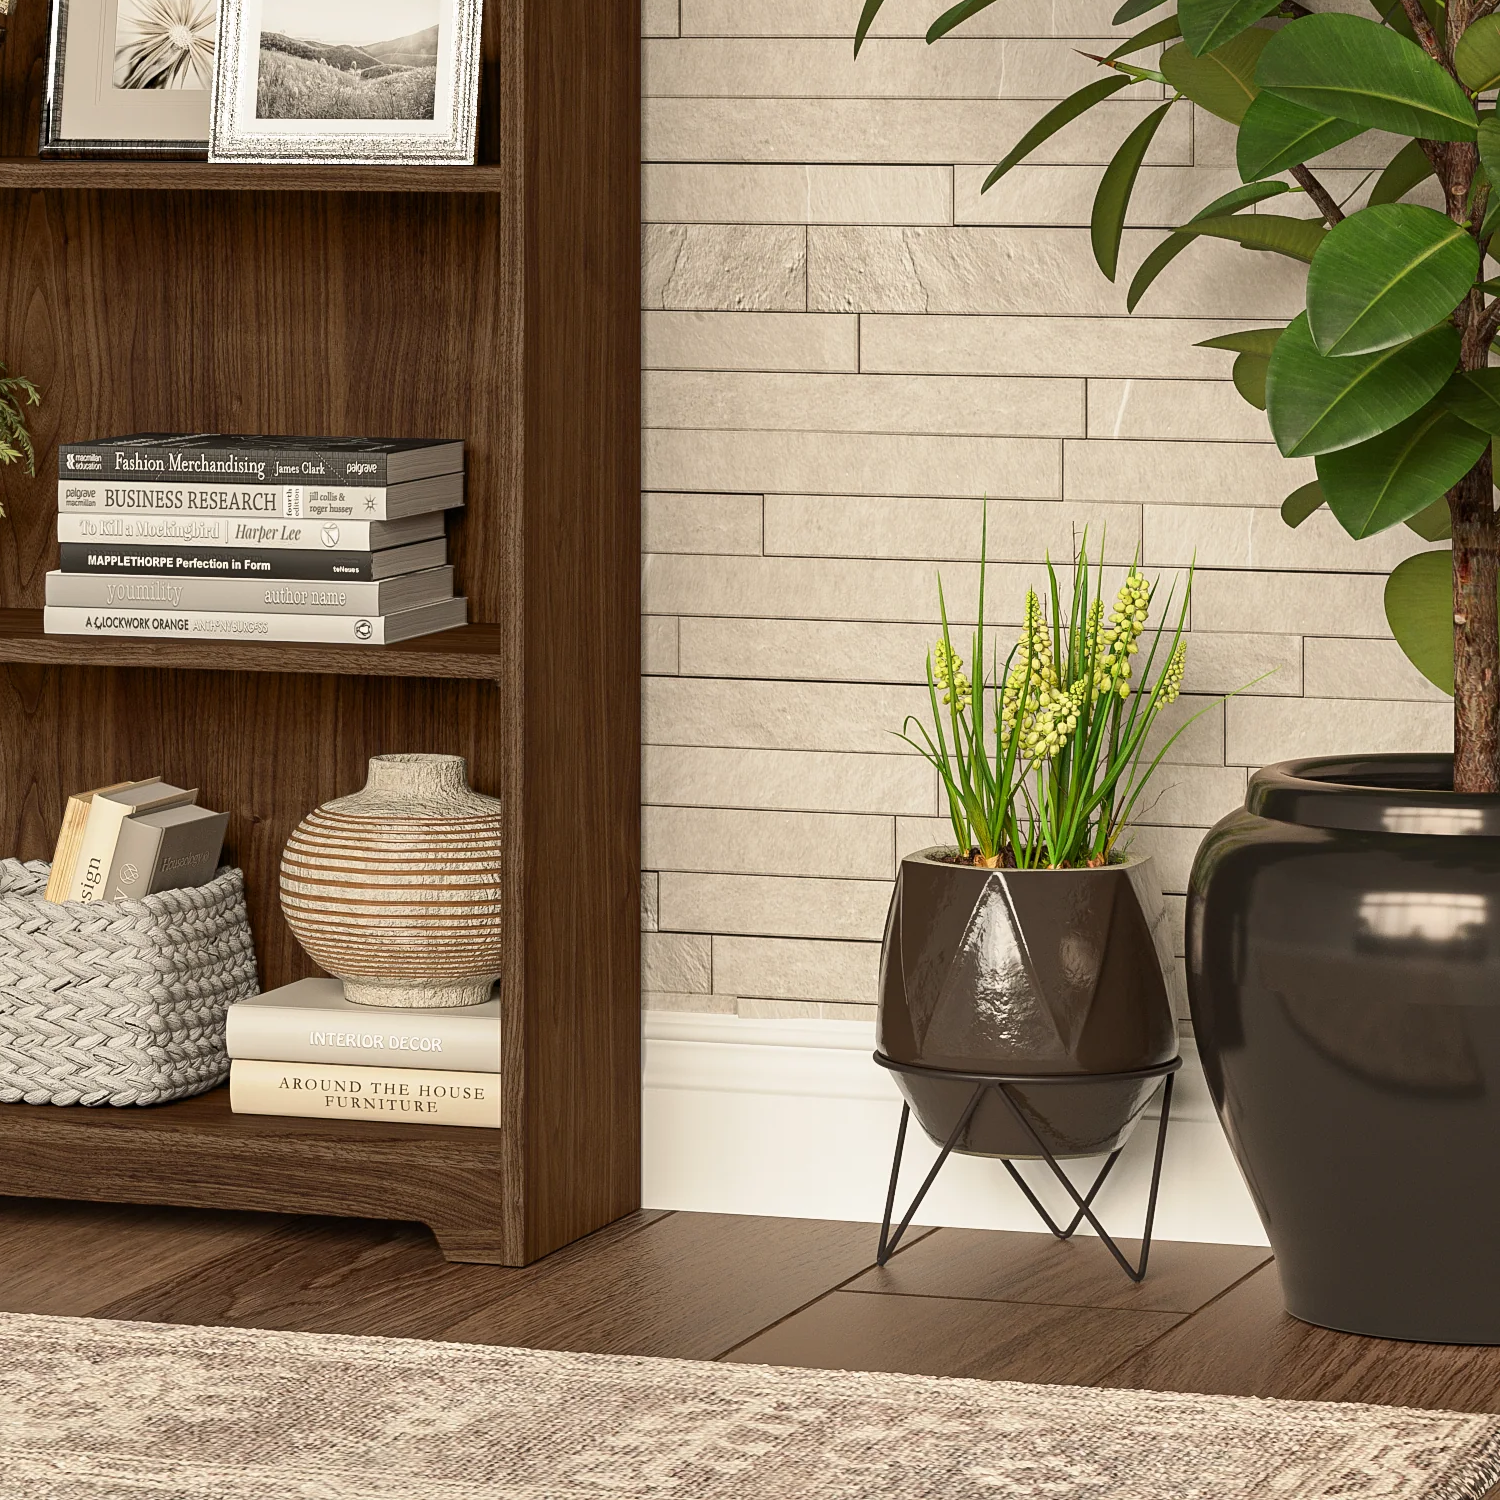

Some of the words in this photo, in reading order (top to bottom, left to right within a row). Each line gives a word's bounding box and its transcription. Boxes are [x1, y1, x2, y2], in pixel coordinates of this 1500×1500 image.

[75, 454, 102, 462] macmillan
[75, 462, 102, 470] education
[114, 451, 165, 471] Fashion
[168, 452, 266, 480] Merchandising
[274, 461, 300, 477] James
[301, 461, 326, 475] Clark
[346, 460, 378, 476] palgrave
[65, 487, 96, 499] palgrave
[104, 488, 184, 509] BUSINESS
[187, 491, 277, 511] RESEARCH
[309, 491, 319, 503] jill
[319, 491, 338, 502] collis
[338, 493, 345, 501] &
[65, 499, 96, 507] macmillan
[309, 505, 328, 515] roger
[328, 504, 353, 515] hussey
[80, 519, 97, 536] To
[99, 518, 124, 537] Kill
[125, 525, 133, 537] a
[136, 520, 220, 541] Mockingbird
[235, 523, 278, 541] Harper
[280, 525, 301, 541] Lee
[87, 554, 174, 568] MAPPLETHORPE
[176, 557, 229, 569] Perfection
[231, 559, 242, 570] in
[244, 559, 271, 571] Form
[107, 580, 183, 607] youmility
[264, 587, 308, 605] author
[311, 591, 347, 606] name
[85, 616, 93, 628] A
[94, 616, 150, 630] CLOCKWORK
[152, 618, 189, 631] ORANGE
[80, 857, 101, 904] sign
[309, 1031, 385, 1049] INTERIOR
[388, 1035, 443, 1052] DECOR
[278, 1076, 362, 1093] AROUND
[370, 1082, 410, 1096] THE
[419, 1085, 485, 1100] HOUSE
[324, 1095, 439, 1113] FURNITURE
